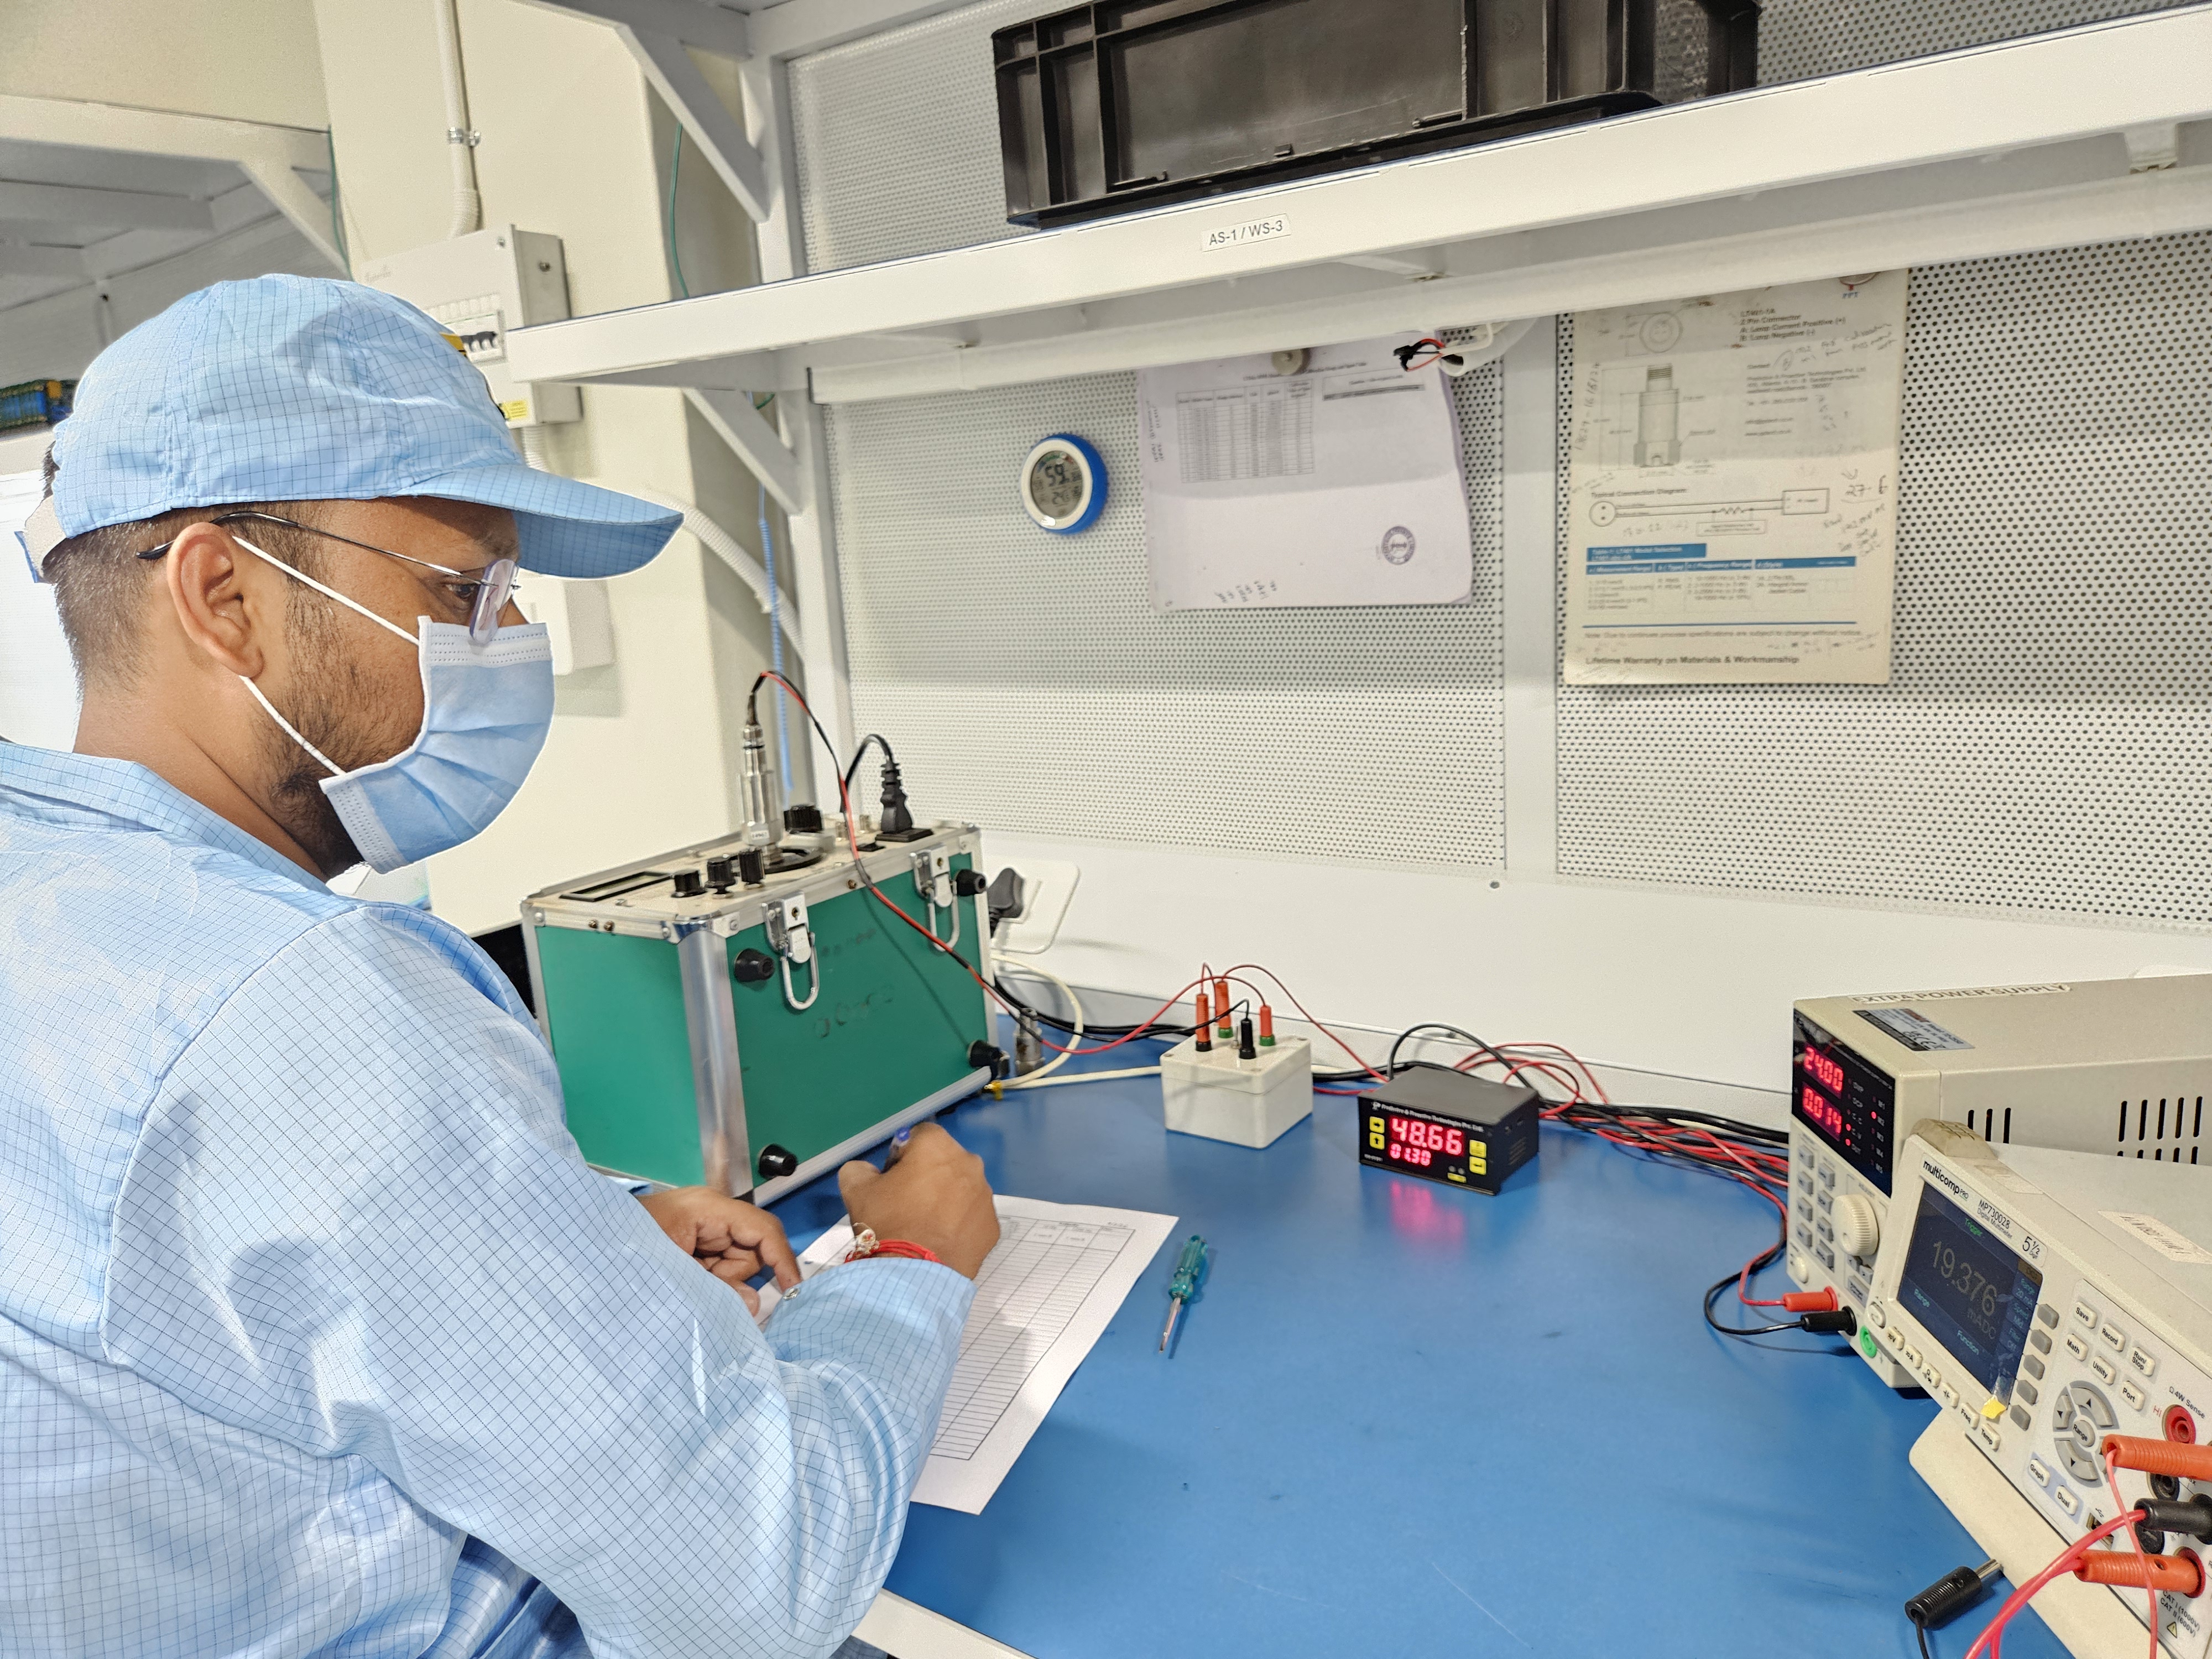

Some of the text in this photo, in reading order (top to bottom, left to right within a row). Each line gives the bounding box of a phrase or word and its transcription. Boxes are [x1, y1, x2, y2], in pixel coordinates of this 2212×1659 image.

[1209, 229, 1237, 246] AS-1
[1249, 220, 1283, 237] WS-3
[1916, 989, 1986, 1000] POWER
[1990, 984, 2067, 995] SUPPLY
[1391, 1118, 1463, 1155] 48.66
[1923, 1160, 1960, 1196] multicomp
[1933, 1240, 1997, 1317] 19.376
[2075, 1307, 2090, 1322] Save
[2101, 1328, 2119, 1345] Record
[2067, 1339, 2080, 1355] Math
[2131, 1356, 2145, 1371] Stop
[2133, 1350, 2147, 1364] Run/
[2092, 1360, 2108, 1379] Utility
[2122, 1387, 2136, 1403] Port
[1960, 1410, 1971, 1424] Freq
[2153, 1405, 2162, 1418] HI
[2186, 1399, 2205, 1419] Sense
[1981, 1428, 1994, 1446] Temp
[2073, 1423, 2088, 1441] Range
[2030, 1463, 2044, 1482] Graph
[2057, 1491, 2070, 1508] Dual
[2160, 1597, 2173, 1612] CAT
[2177, 1615, 2196, 1638] (600V)
[2163, 1590, 2175, 1604] CAT
[2178, 1605, 2200, 1631] (1000V)
